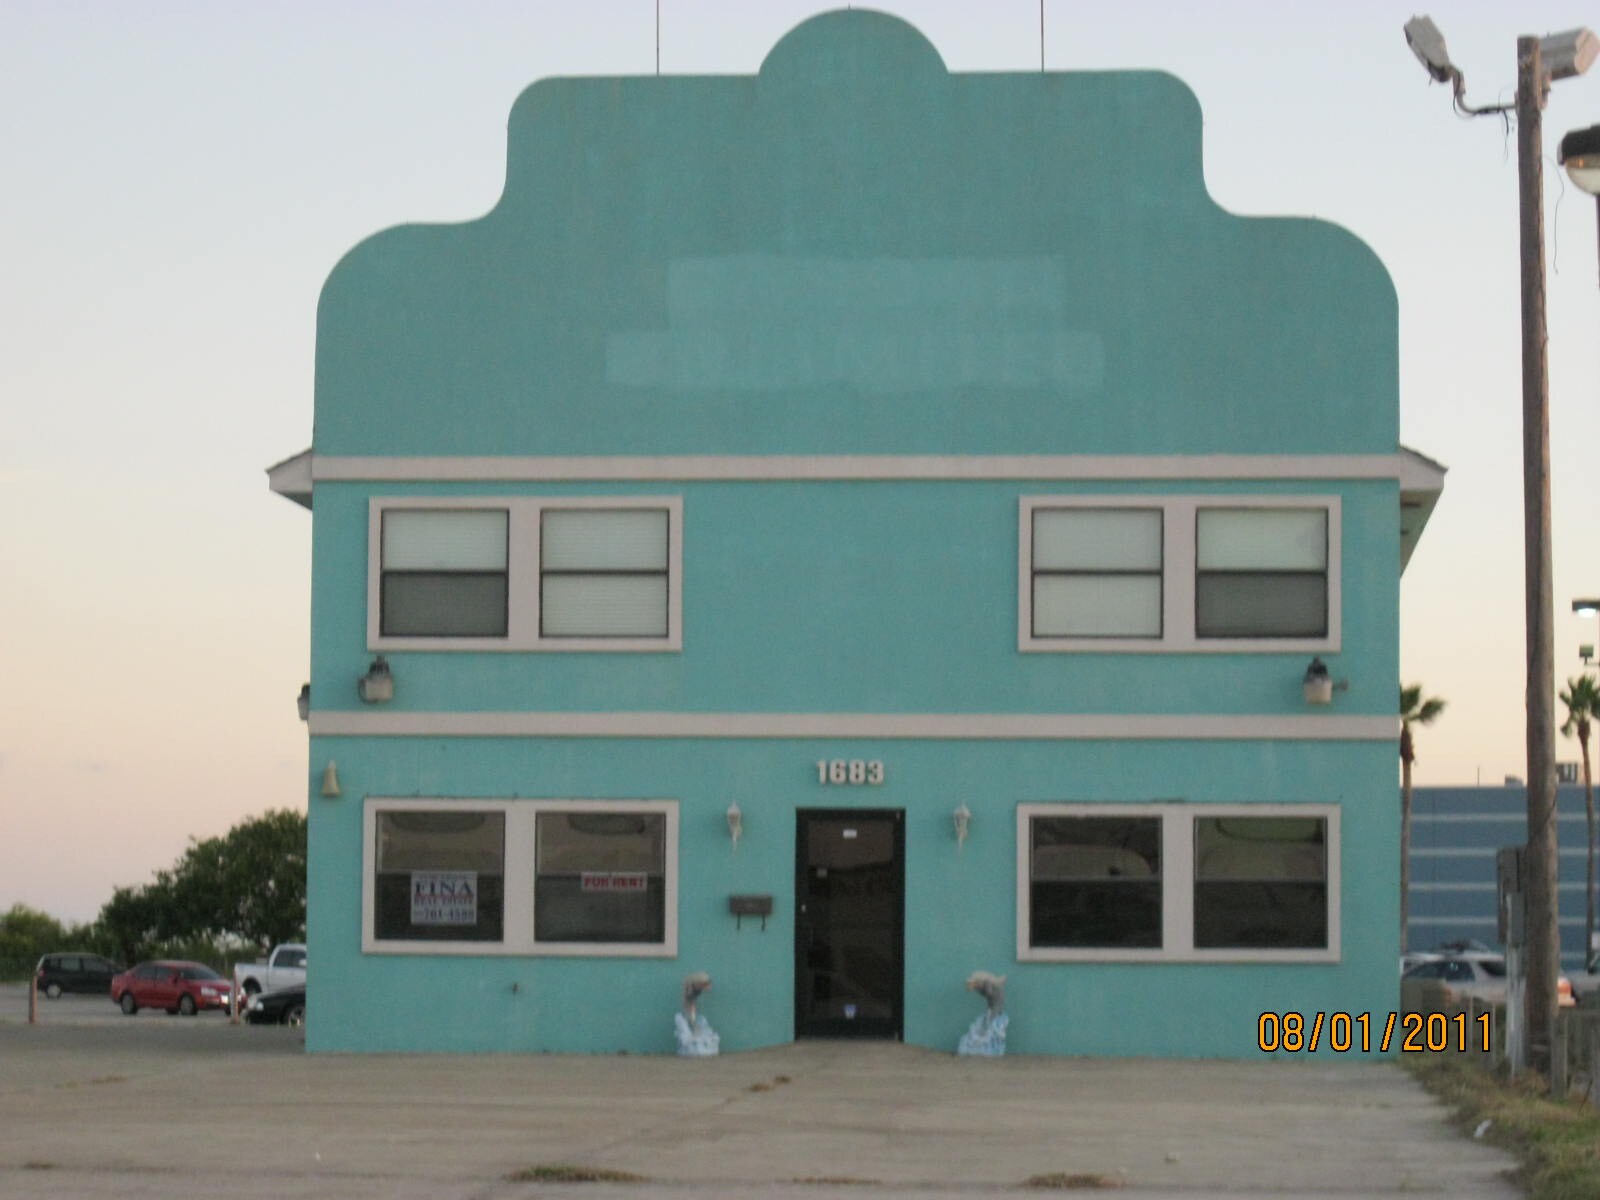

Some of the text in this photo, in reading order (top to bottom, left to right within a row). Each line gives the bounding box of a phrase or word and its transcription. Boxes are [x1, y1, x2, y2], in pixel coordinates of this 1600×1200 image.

[816, 759, 885, 785] 1683
[415, 880, 474, 897] FINA
[583, 877, 609, 888] FOR
